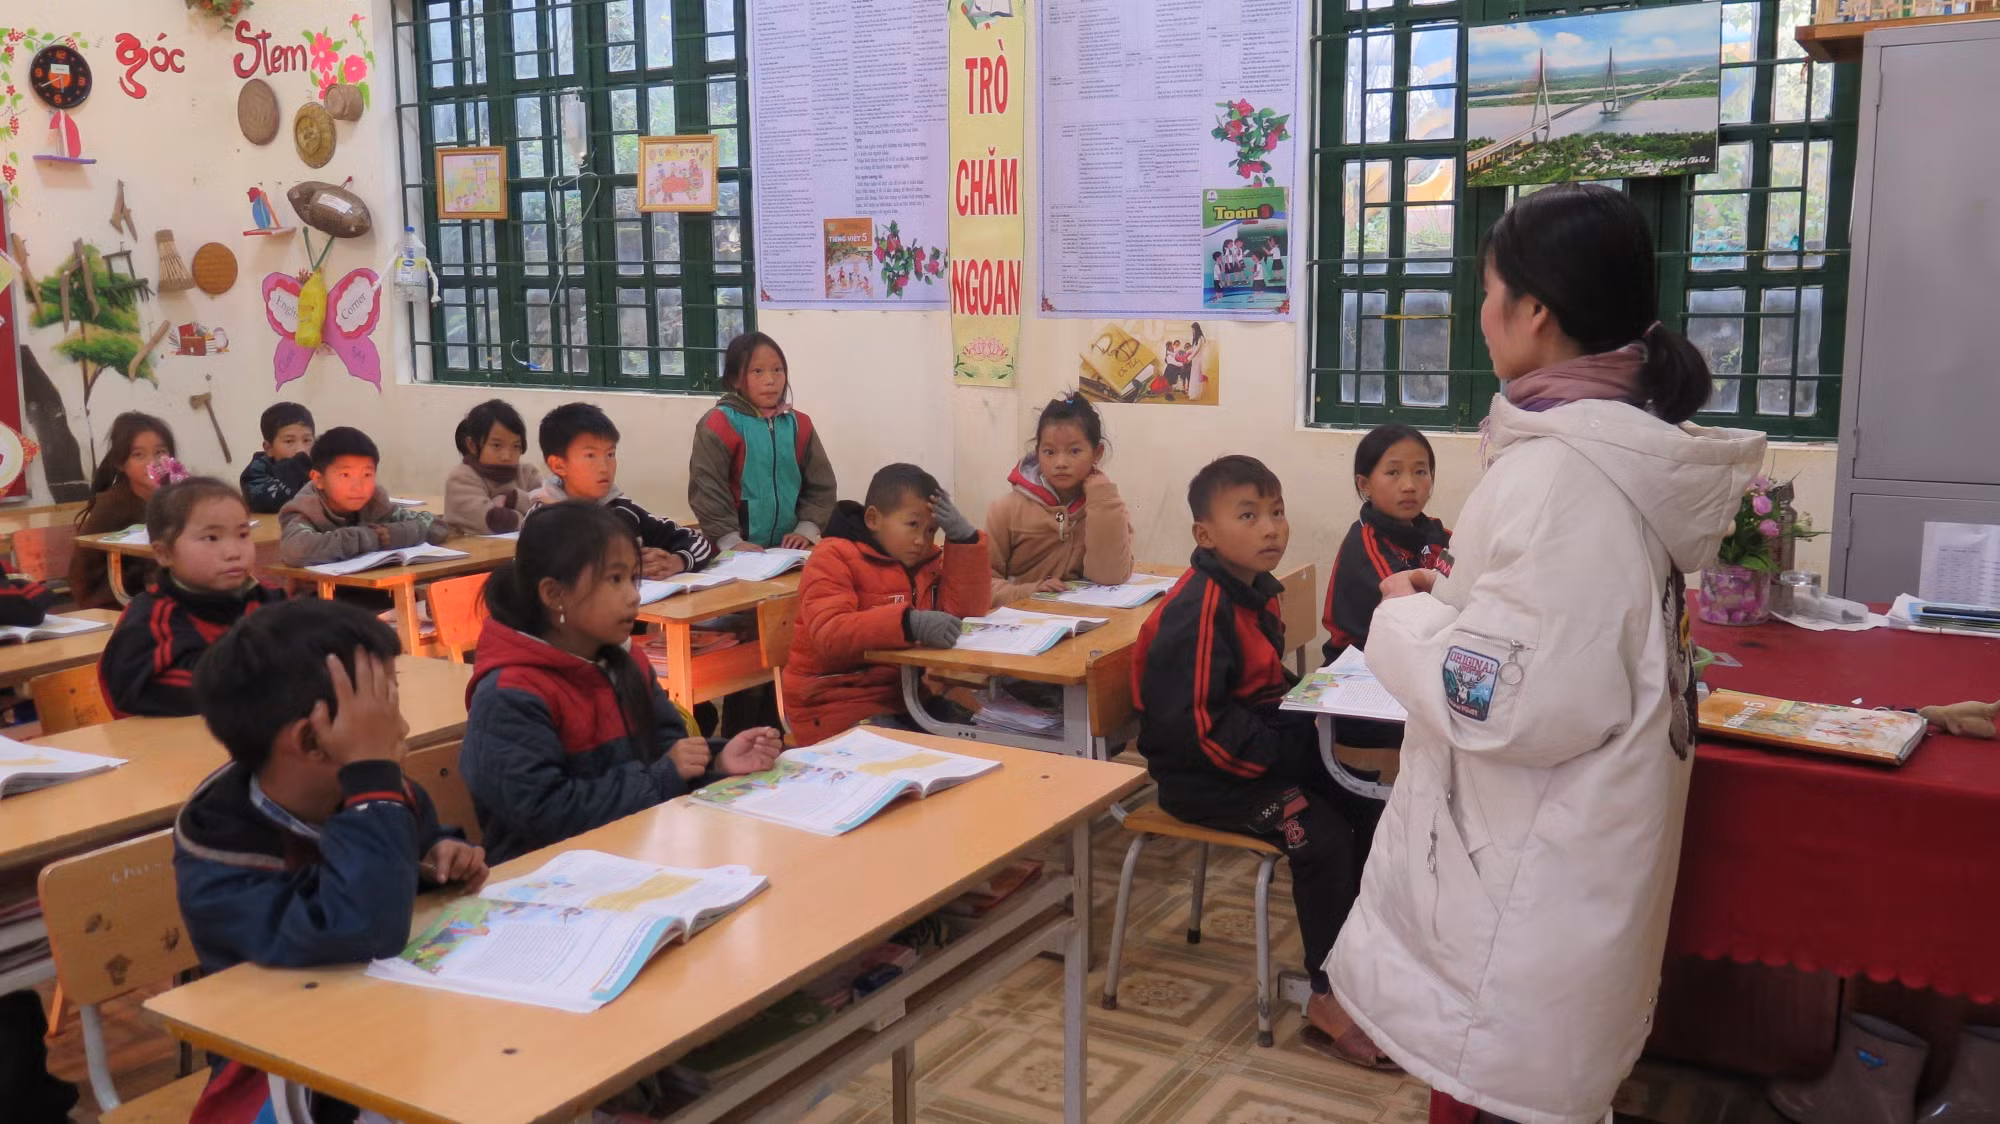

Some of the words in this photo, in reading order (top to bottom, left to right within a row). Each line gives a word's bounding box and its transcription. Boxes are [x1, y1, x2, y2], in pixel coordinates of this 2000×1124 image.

[233, 20, 307, 79] Stem
[965, 39, 1009, 115] TRÒ
[955, 146, 1019, 217] CHĂM
[1213, 205, 1259, 221] Toán
[862, 232, 868, 242] 5
[341, 293, 367, 320] Corner
[952, 258, 1022, 316] NGOAN
[1450, 651, 1496, 675] ORIGINAL
